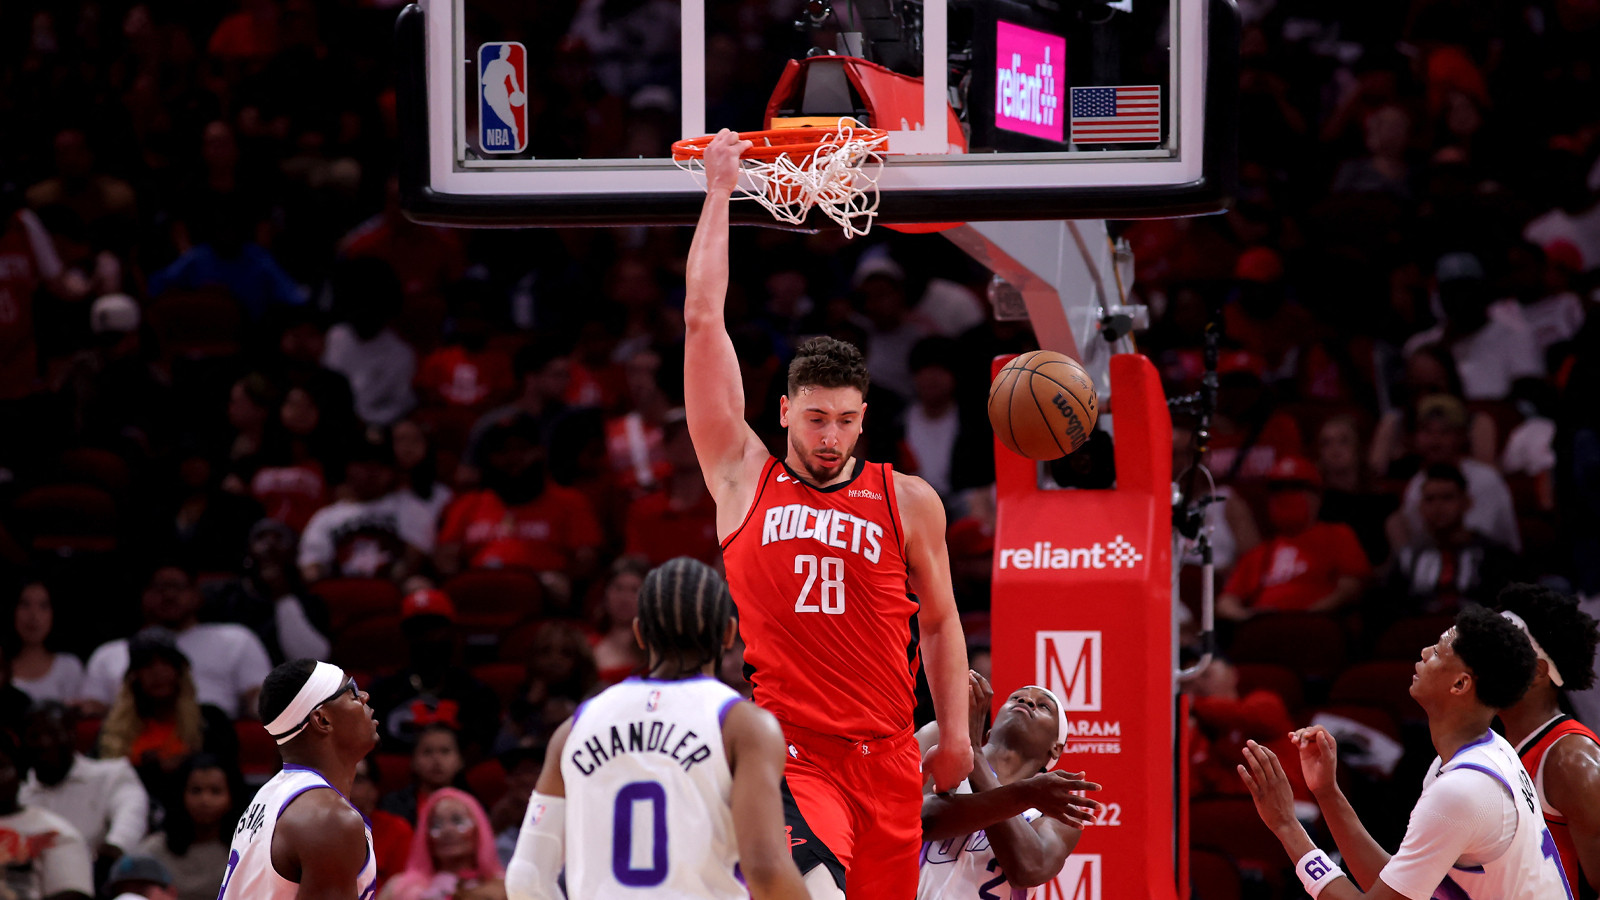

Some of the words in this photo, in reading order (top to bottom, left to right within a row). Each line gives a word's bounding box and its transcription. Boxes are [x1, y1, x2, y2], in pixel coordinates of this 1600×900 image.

[996, 53, 1041, 124] reliant
[486, 128, 510, 146] NBA
[761, 503, 883, 565] ROCKETS
[999, 541, 1106, 569] reliant
[794, 554, 846, 615] 28
[571, 721, 711, 776] CHANDLER
[1067, 720, 1121, 736] ARAM
[612, 781, 669, 887] 0
